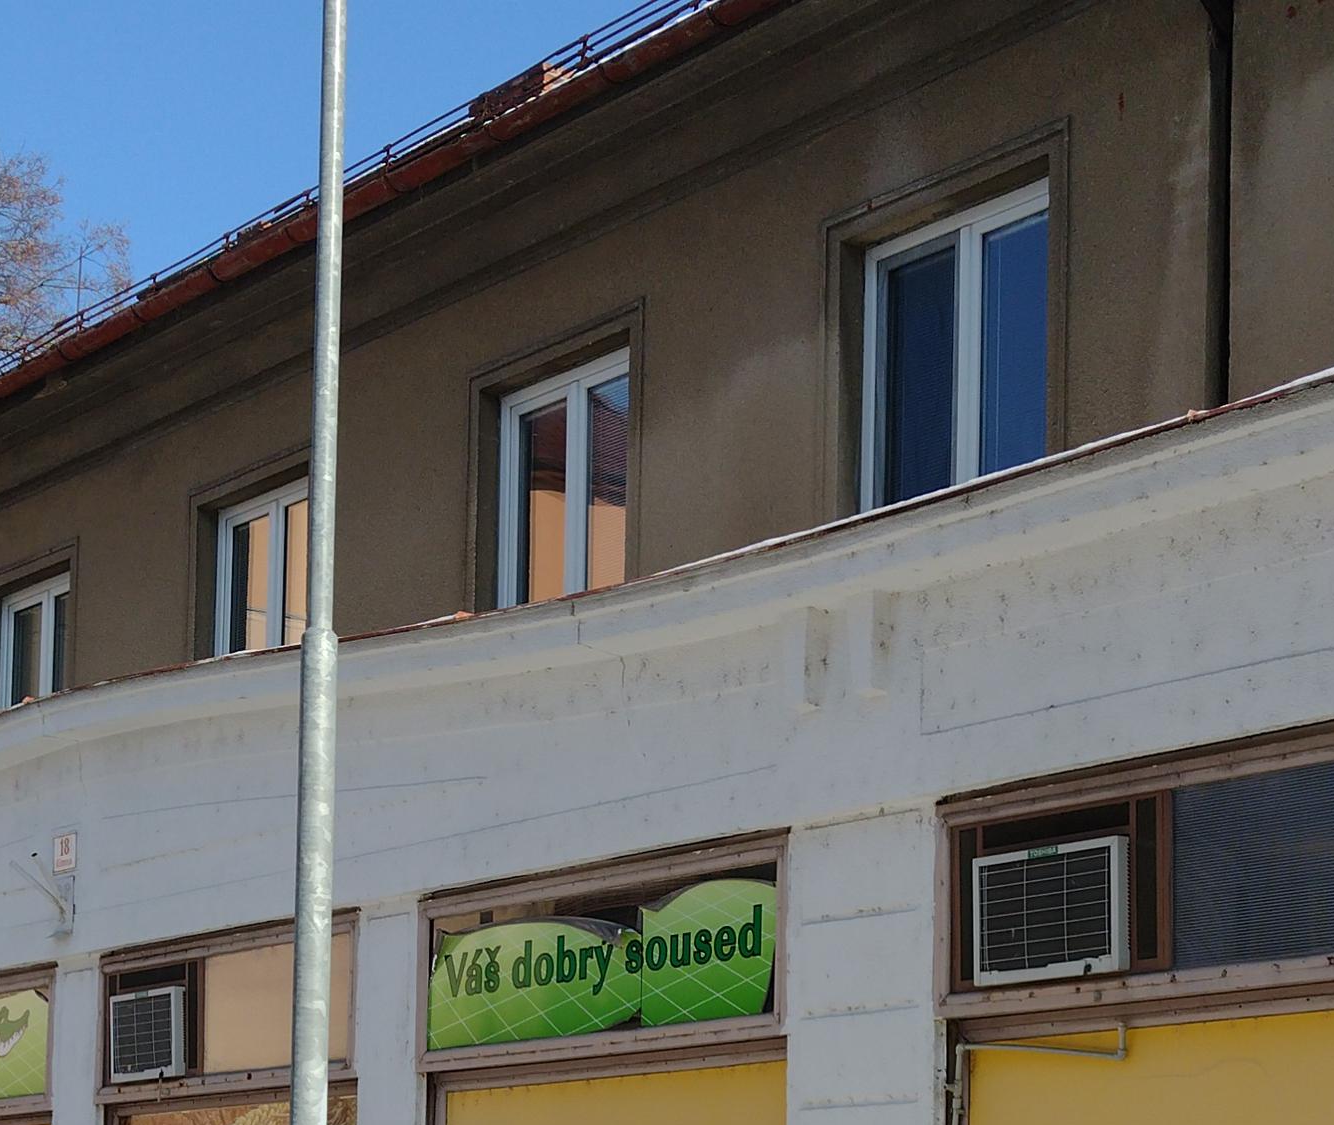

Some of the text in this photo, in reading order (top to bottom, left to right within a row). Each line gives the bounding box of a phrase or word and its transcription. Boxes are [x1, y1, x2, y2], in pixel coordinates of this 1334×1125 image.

[60, 837, 70, 856] 18
[443, 944, 502, 998] Váš
[624, 904, 764, 975] soused
